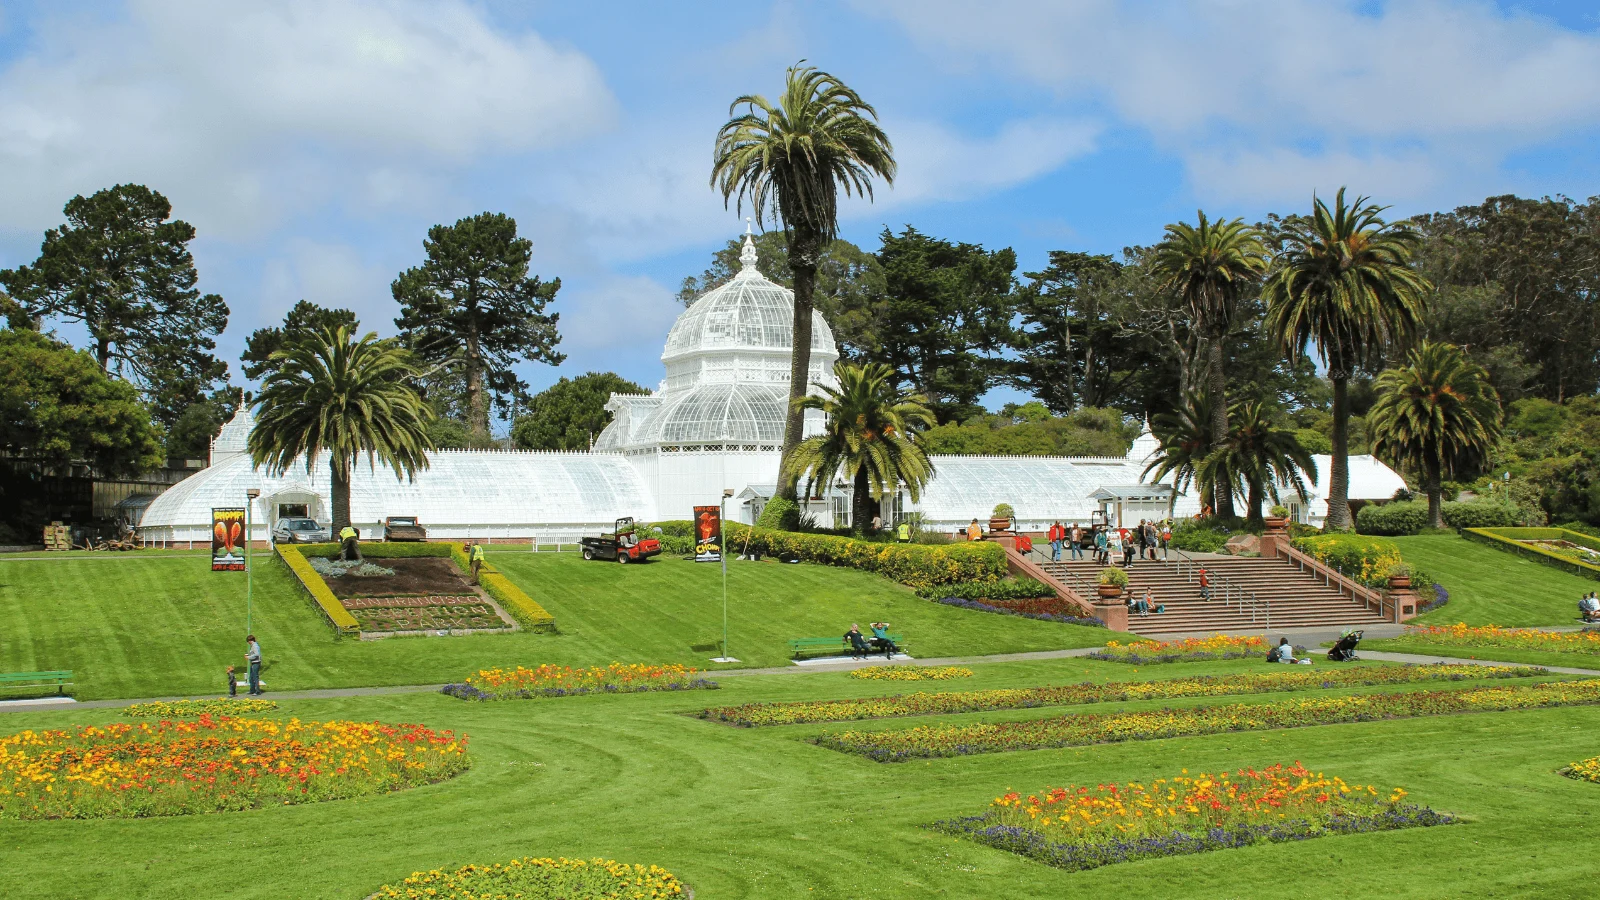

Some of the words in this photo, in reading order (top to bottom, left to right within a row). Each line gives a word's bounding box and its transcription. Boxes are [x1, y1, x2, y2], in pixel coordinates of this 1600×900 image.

[342, 598, 381, 607] SAN
[385, 596, 481, 606] FRANCISCO
[396, 617, 489, 629] PARKS
